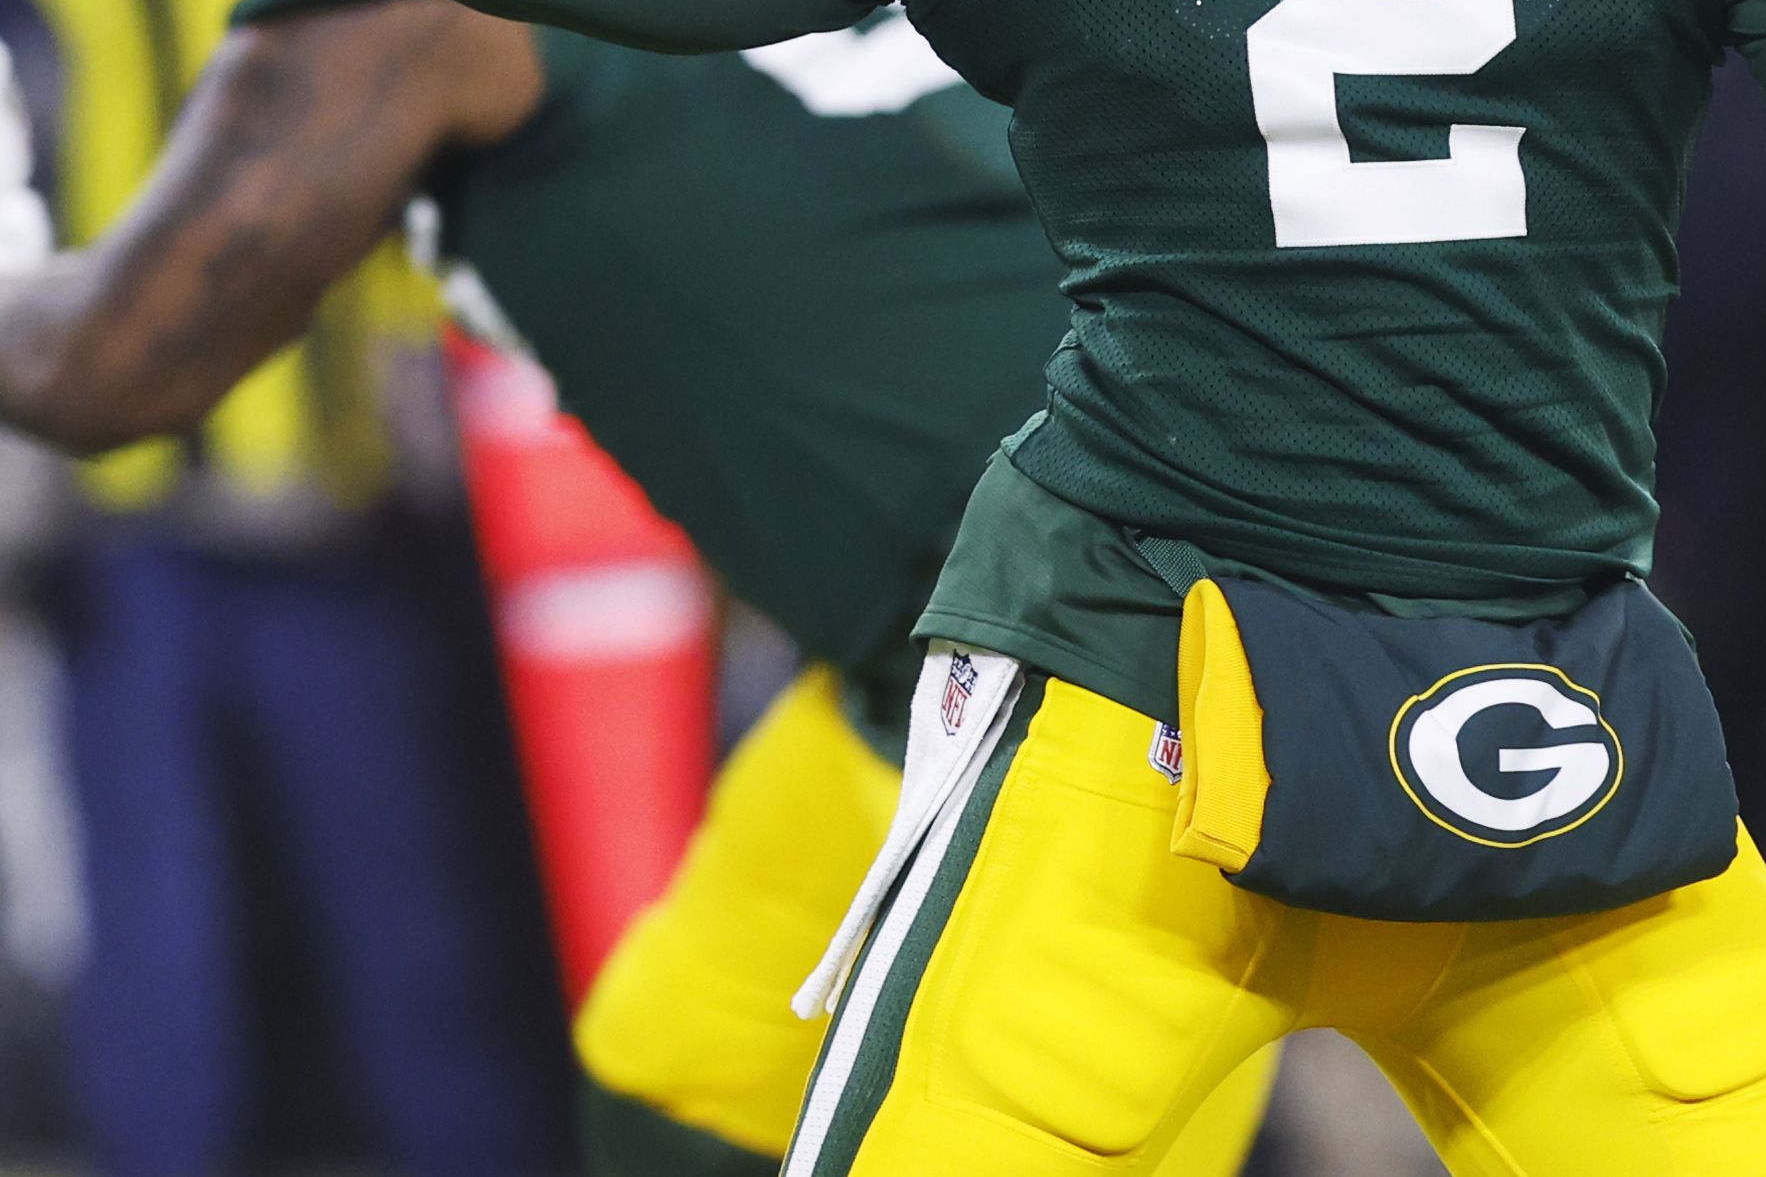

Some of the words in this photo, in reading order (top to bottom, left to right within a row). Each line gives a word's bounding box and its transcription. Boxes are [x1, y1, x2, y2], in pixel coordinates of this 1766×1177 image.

[942, 678, 968, 728] NFL
[1158, 739, 1182, 771] NF
[1408, 678, 1610, 831] G
